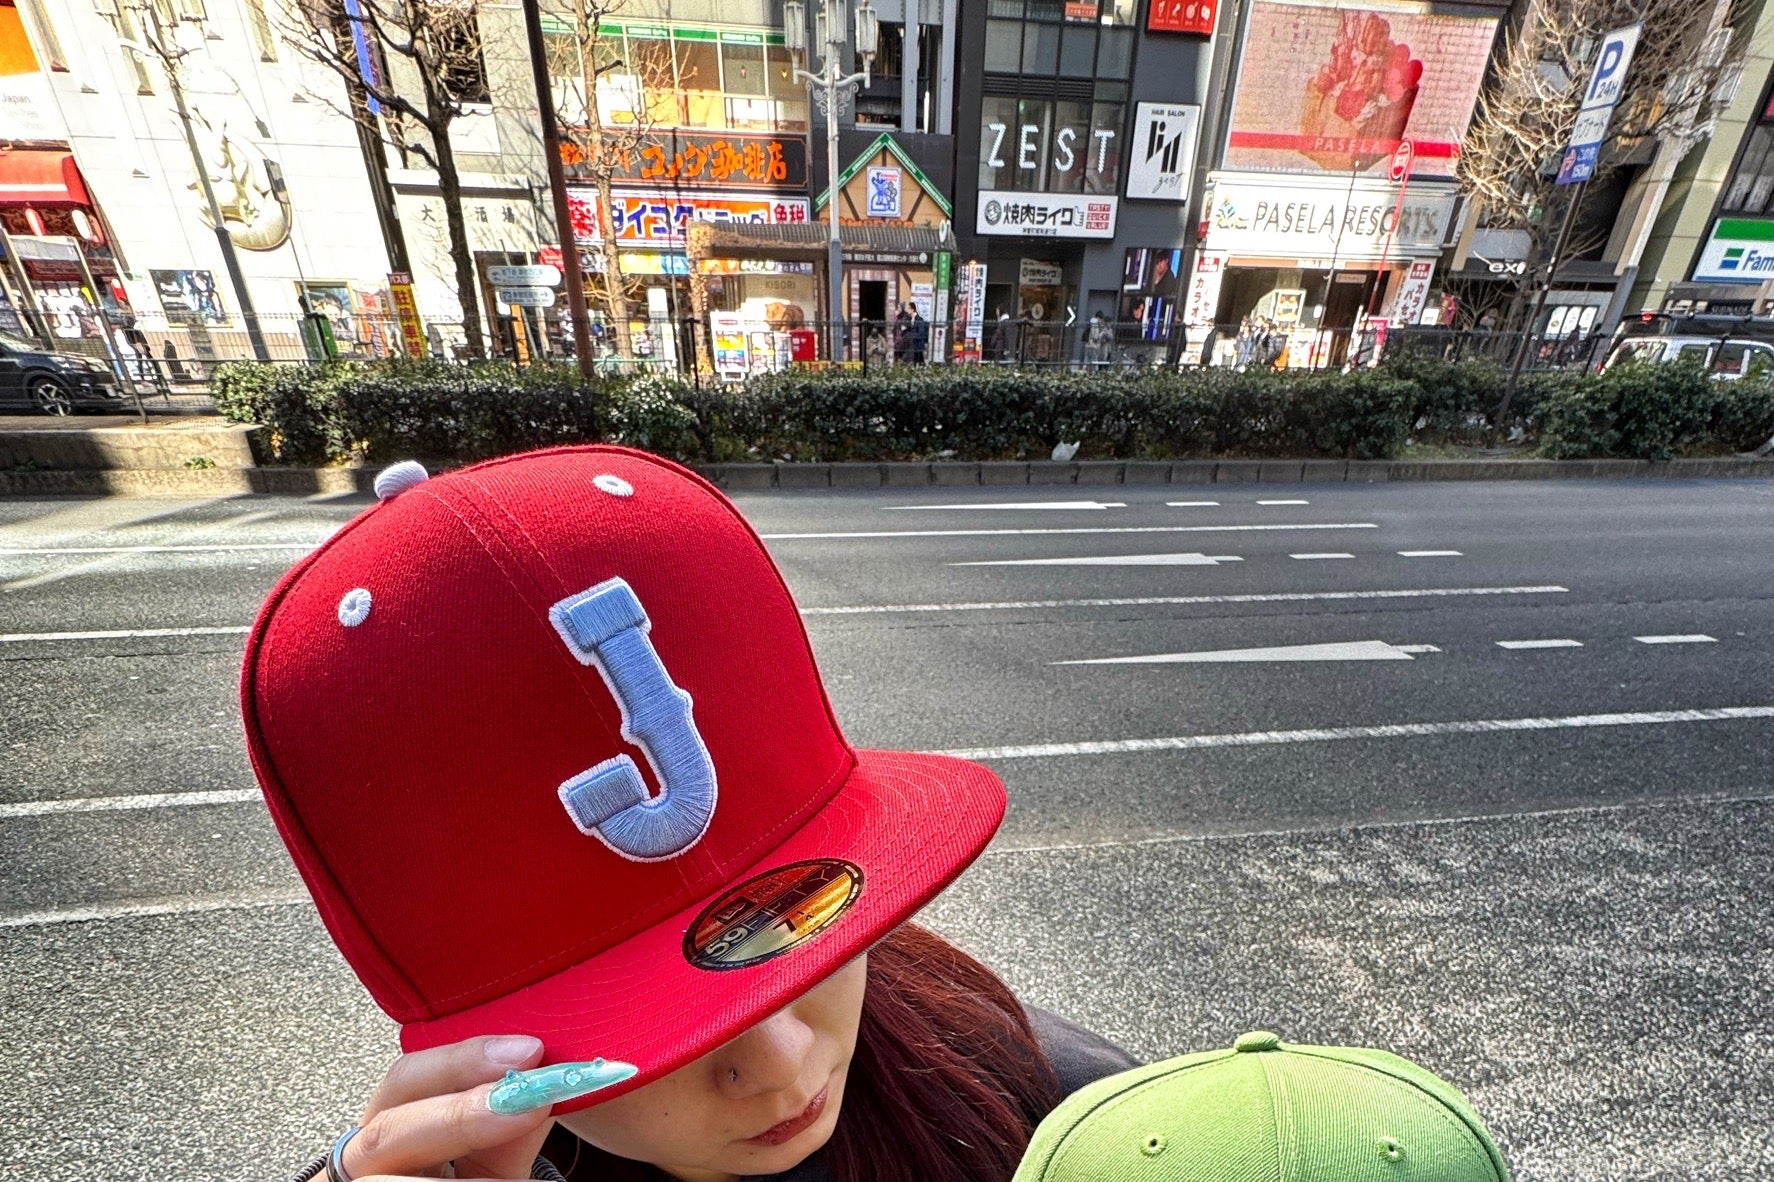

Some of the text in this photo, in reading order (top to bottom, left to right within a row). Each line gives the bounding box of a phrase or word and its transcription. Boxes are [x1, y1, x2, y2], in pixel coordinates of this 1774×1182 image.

[1589, 40, 1624, 101] P
[1598, 81, 1619, 99] 24H
[1151, 109, 1165, 117] HAIR
[986, 122, 1116, 173] ZEST
[1314, 137, 1381, 153] PASELA
[421, 204, 517, 225] 大酒場
[1003, 203, 1074, 226] 焼肉ライク
[1253, 201, 1336, 234] PASELA
[549, 576, 719, 863] J
